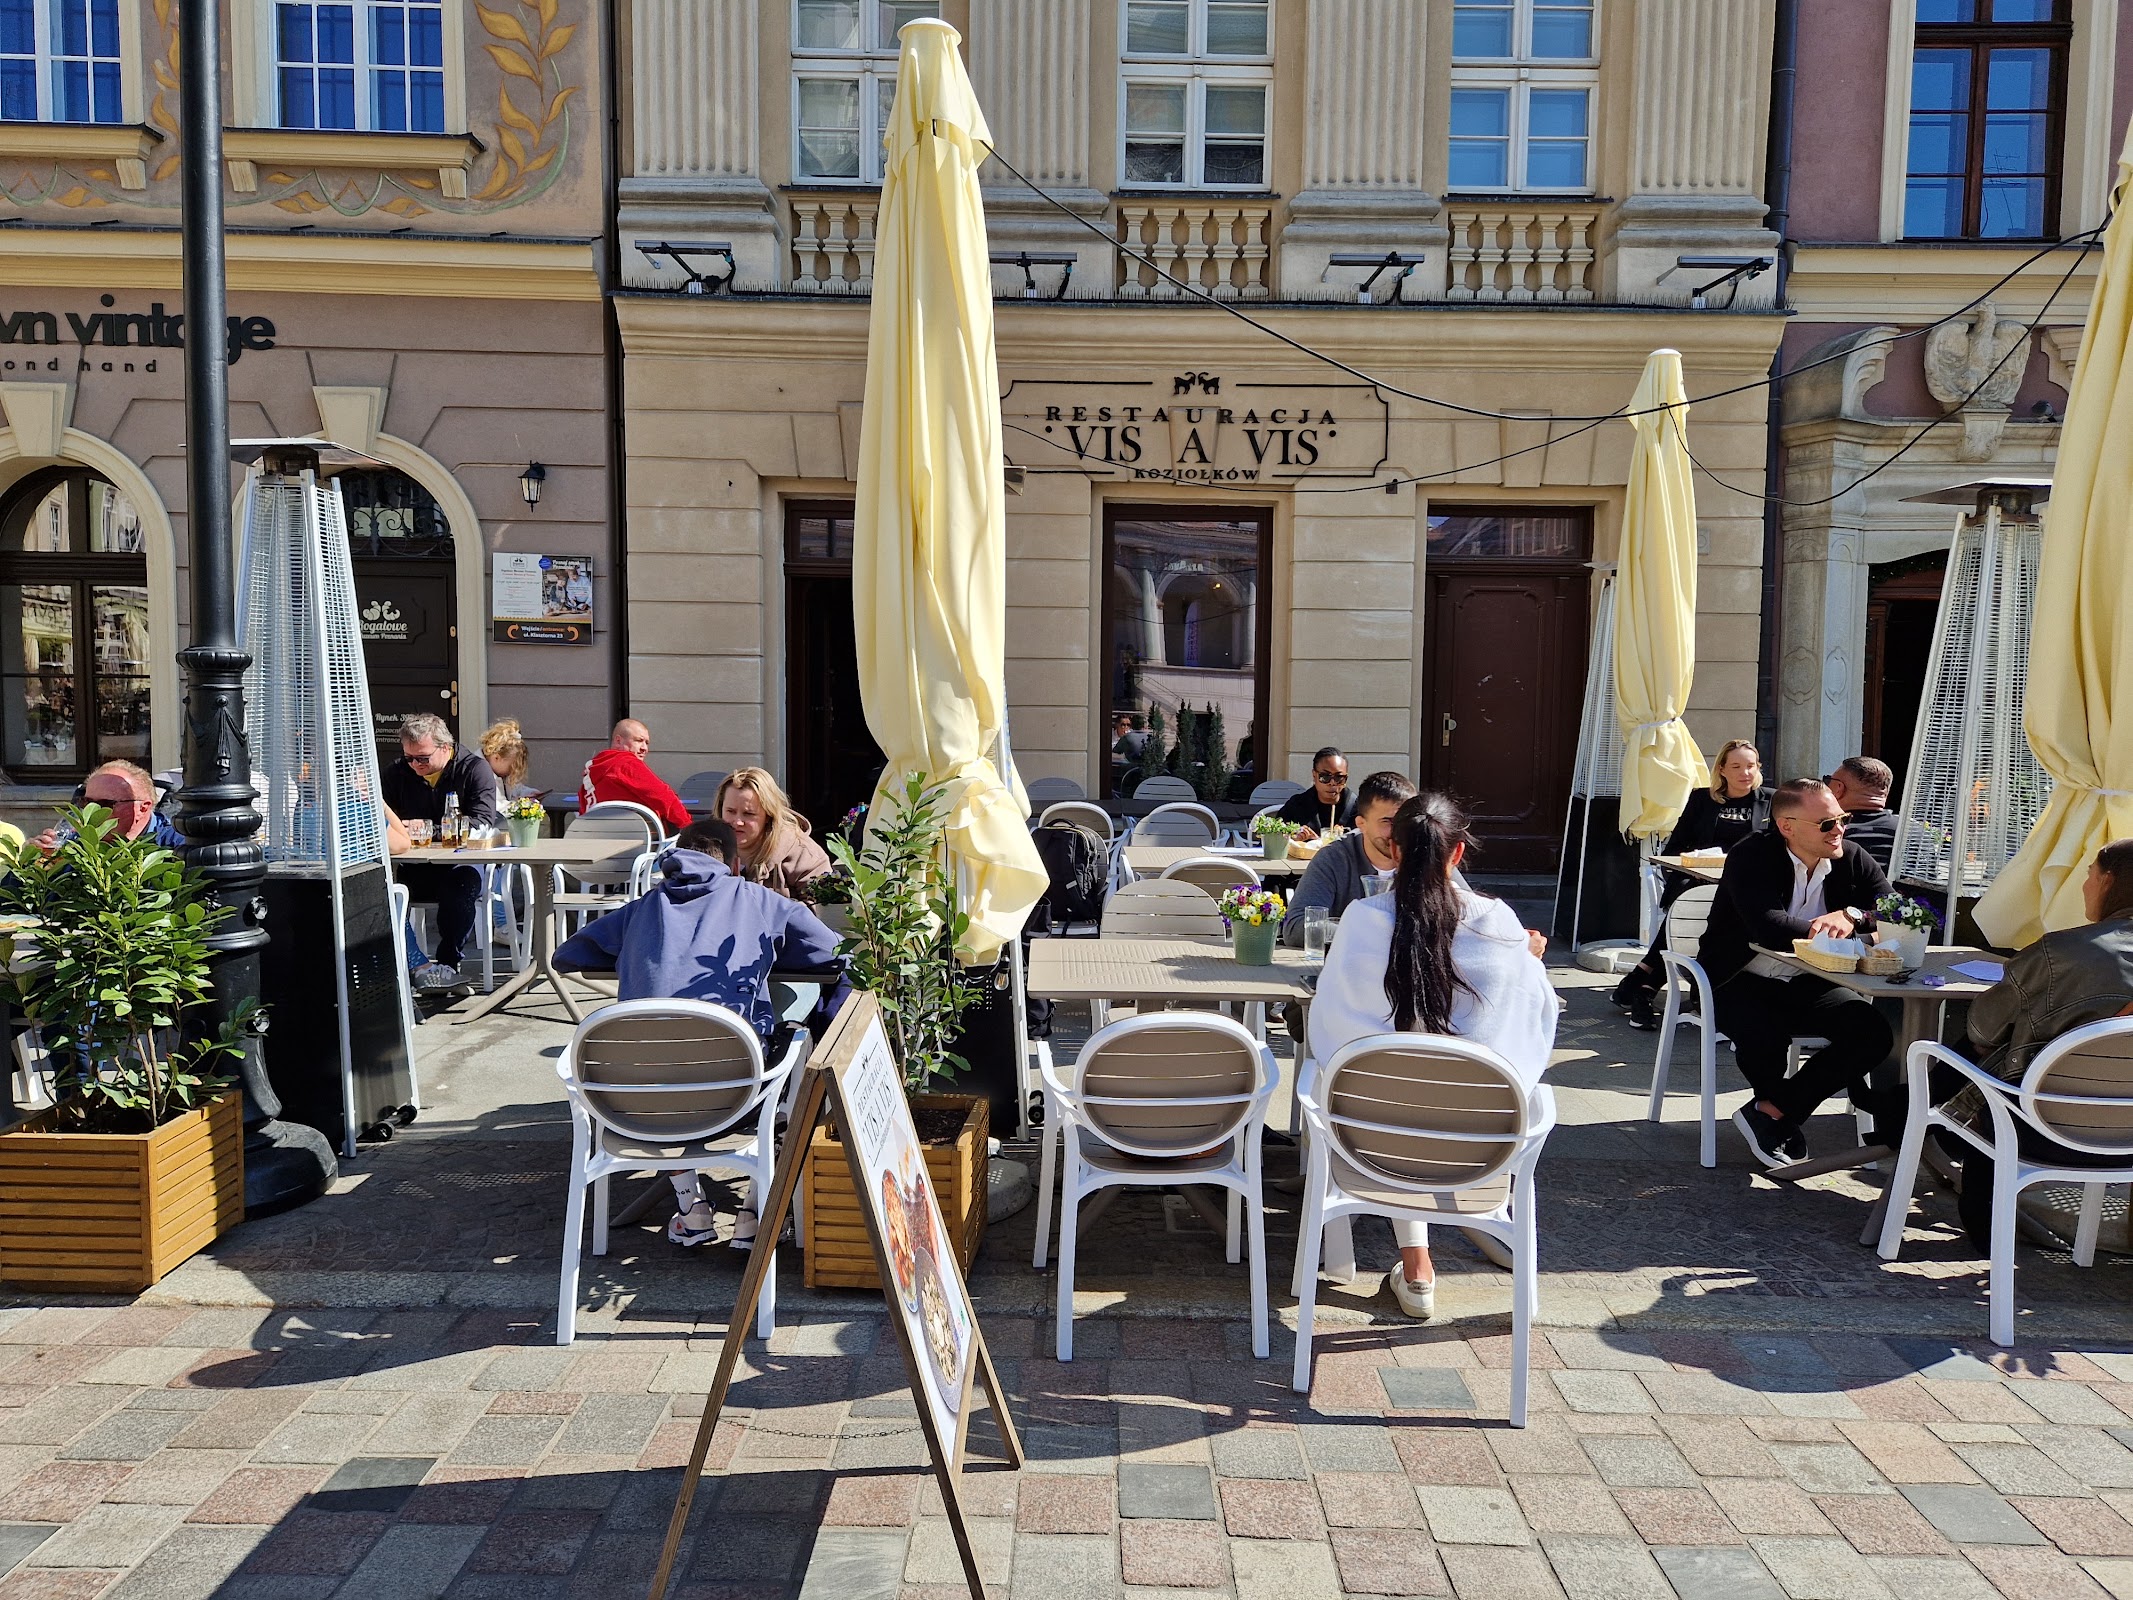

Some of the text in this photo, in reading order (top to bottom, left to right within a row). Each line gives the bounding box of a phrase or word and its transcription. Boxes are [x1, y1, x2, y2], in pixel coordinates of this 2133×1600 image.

[78, 358, 157, 373] hand
[1046, 406, 1336, 425] RESTAURACJA
[1064, 425, 1319, 465] VIS A VIS
[1134, 467, 1260, 481] KOZIOŁKÓW
[375, 713, 399, 723] Rynek
